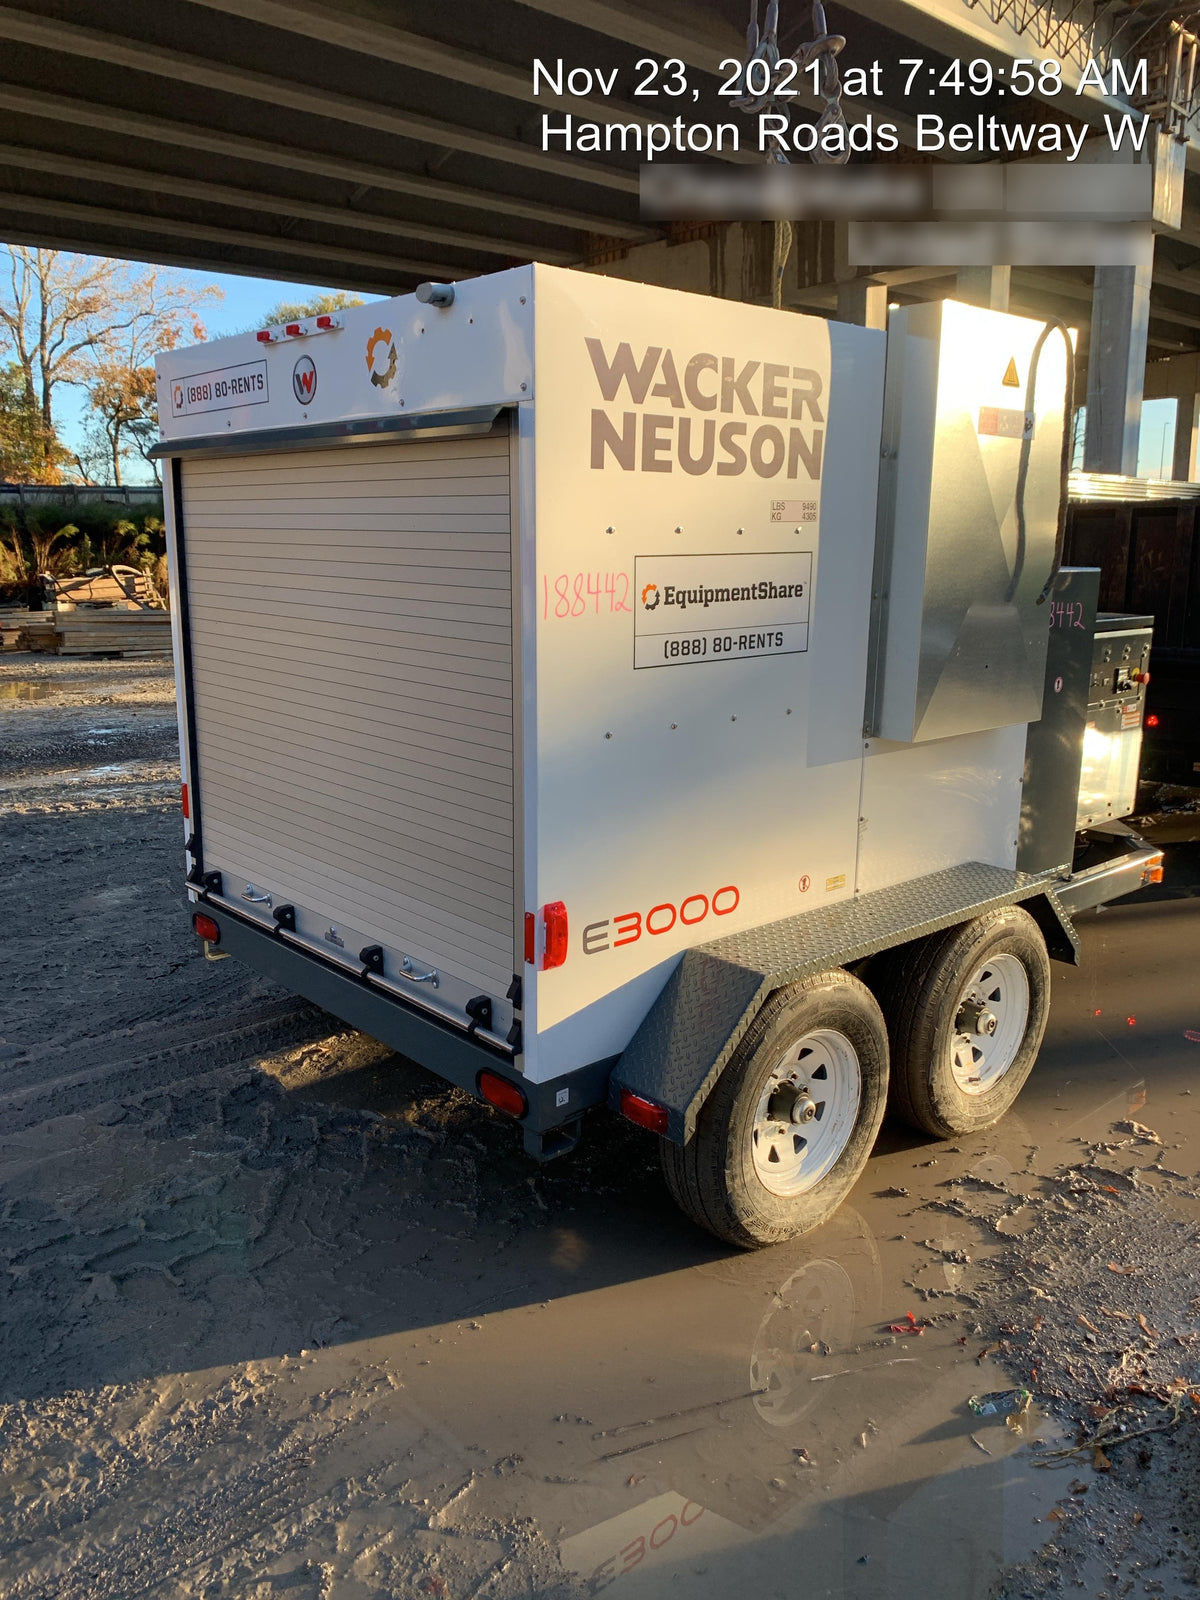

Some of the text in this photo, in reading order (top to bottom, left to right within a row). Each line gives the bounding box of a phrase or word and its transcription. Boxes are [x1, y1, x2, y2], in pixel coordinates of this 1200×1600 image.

[187, 373, 264, 404] (888) 80-RENTS
[584, 336, 825, 423] WACKER
[590, 408, 824, 481] NEUSON
[771, 511, 782, 521] KG
[772, 501, 817, 511] LBS 9490
[543, 572, 633, 620] 188442
[663, 581, 803, 609] EquipmentShare
[664, 631, 784, 659] (888) 80-RENTS
[582, 885, 740, 955] E3000
